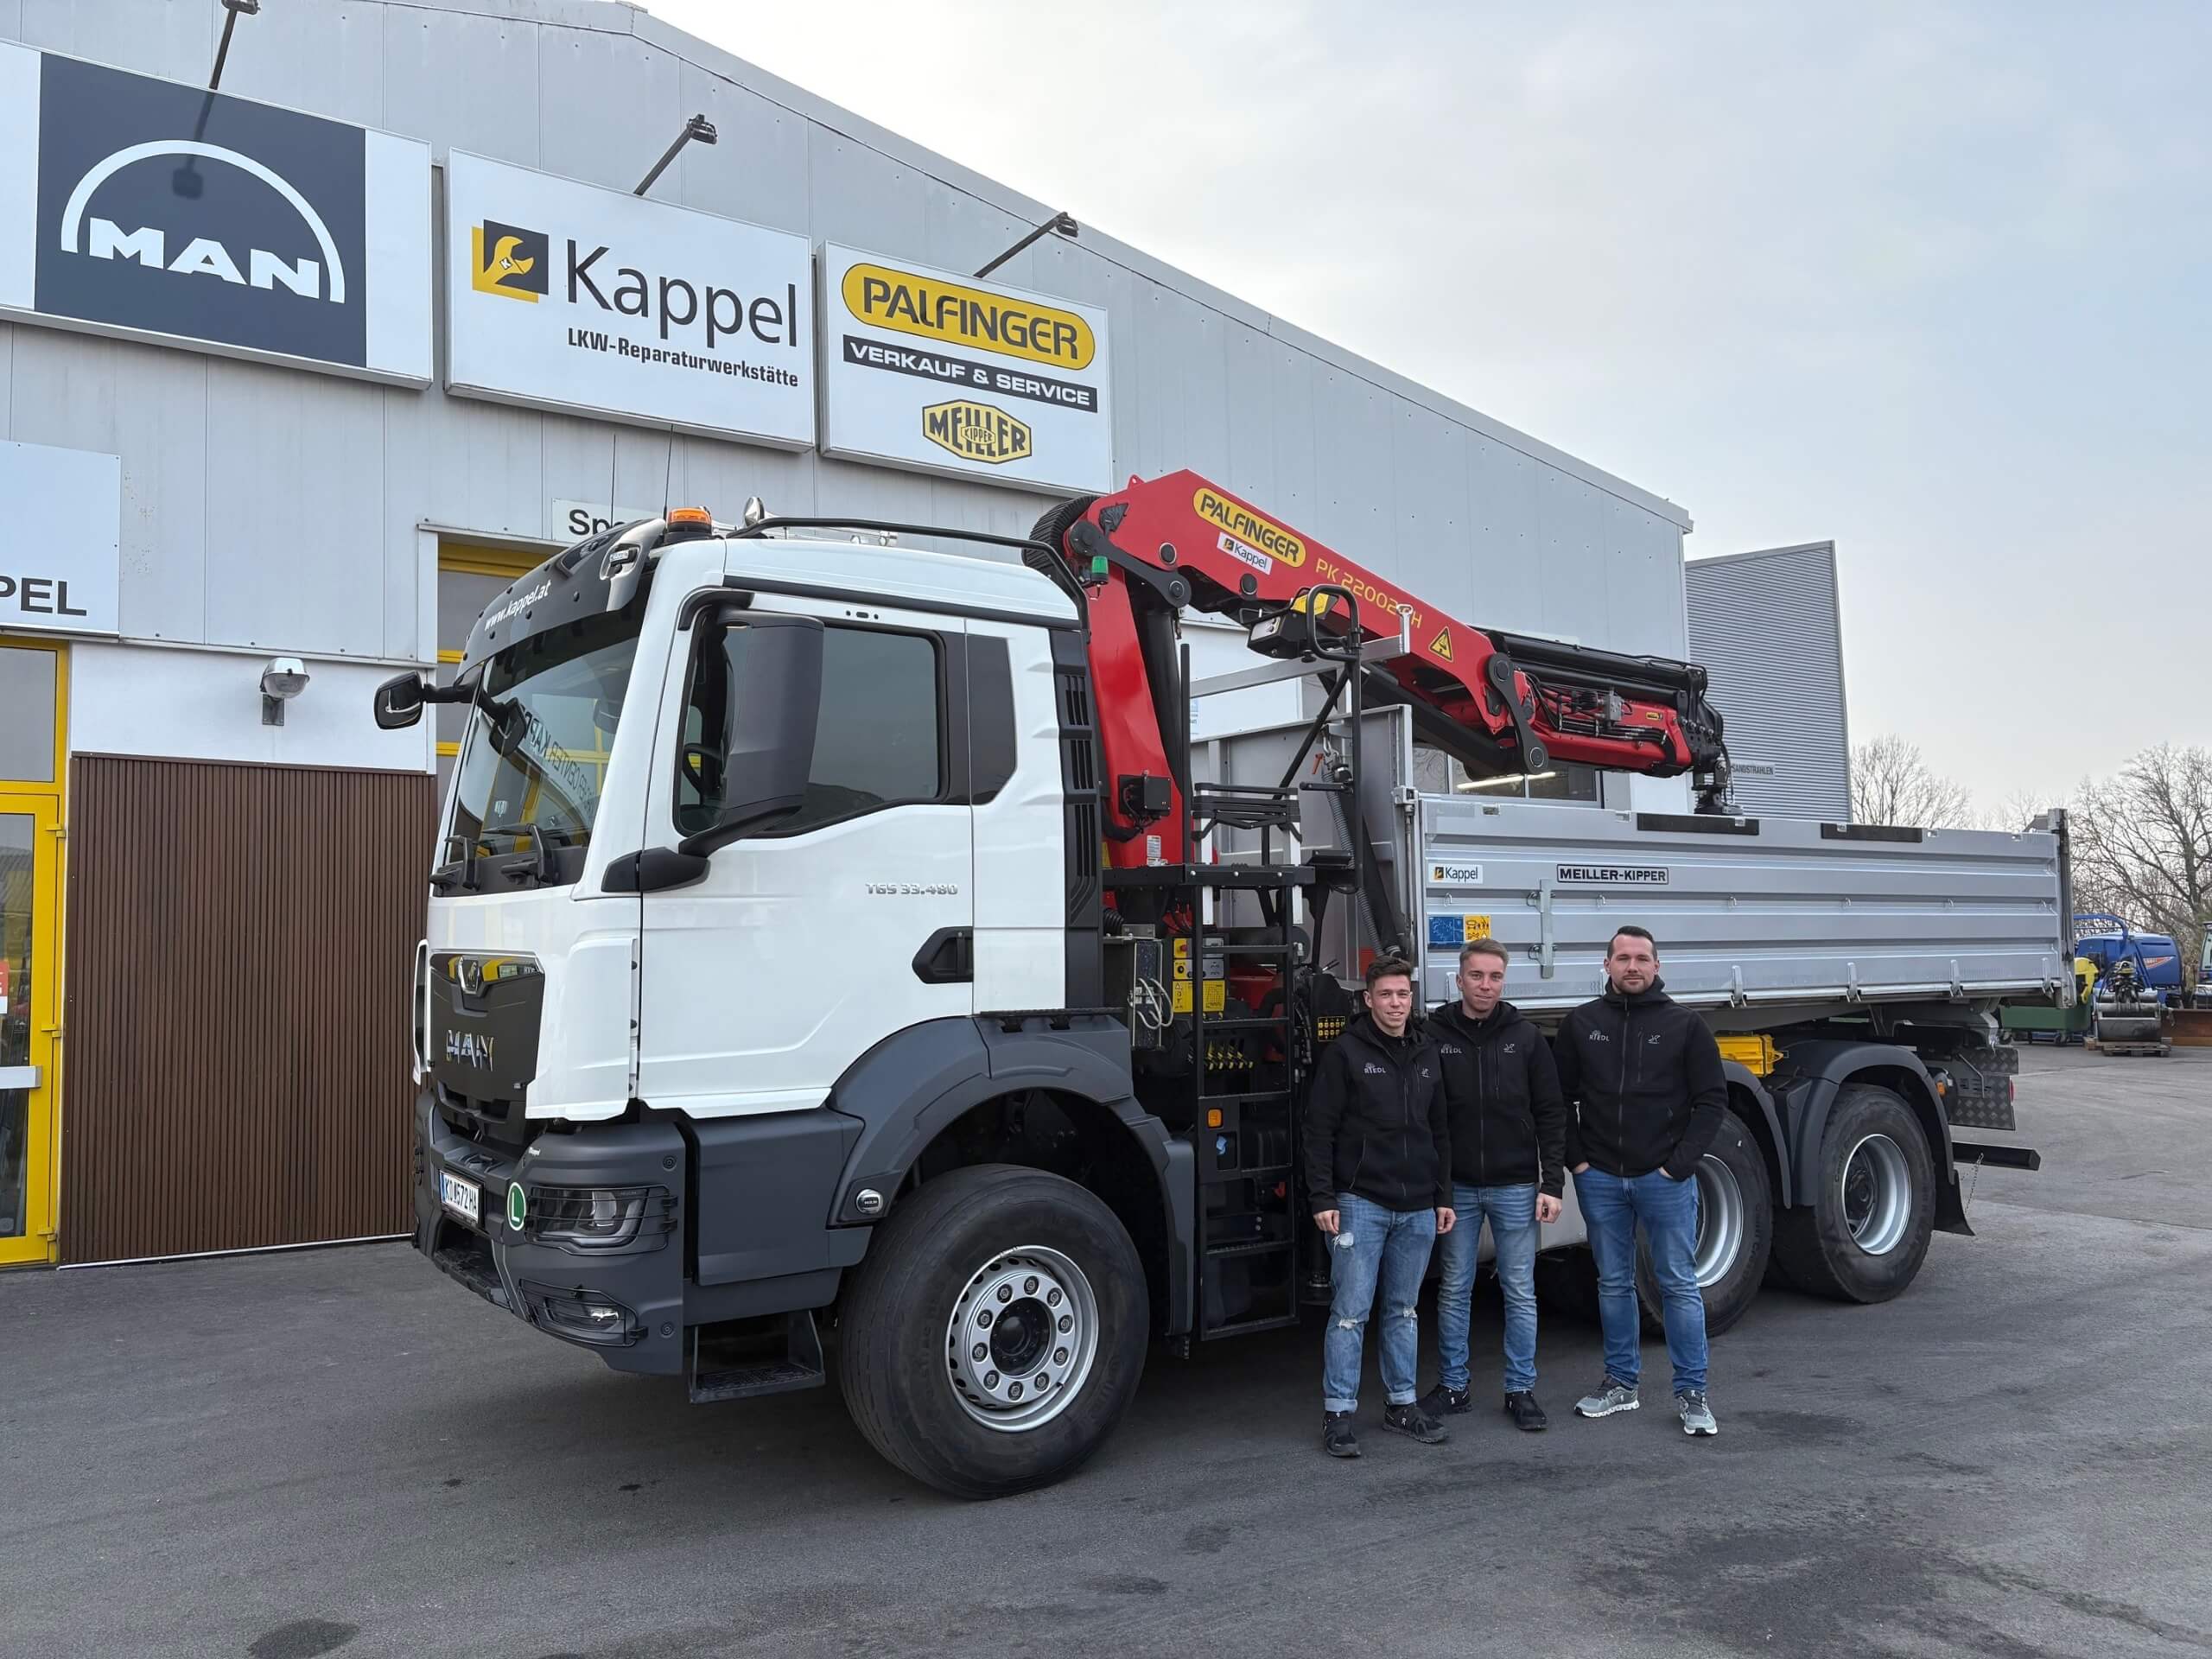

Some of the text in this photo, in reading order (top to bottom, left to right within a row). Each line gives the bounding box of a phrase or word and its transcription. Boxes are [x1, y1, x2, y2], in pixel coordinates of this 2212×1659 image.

[89, 217, 320, 300] MAN
[567, 238, 797, 349] Kappel
[863, 276, 1078, 360] PALFINGER
[568, 327, 798, 387] LKW-Reparaturwerkstätte
[850, 342, 1090, 406] VERKAUF & SERVICE
[929, 406, 1027, 457] MEILLER
[964, 428, 993, 443] KIPPER
[1200, 493, 1300, 563] PALFINGER
[1234, 543, 1268, 570] Kappel
[1315, 558, 1338, 583] PK
[484, 579, 551, 632] www.kappel.at
[865, 883, 958, 895] TGS 33.480
[1445, 867, 1478, 881] Kappel
[1560, 868, 1666, 882] MEILLER-KIPPER
[512, 1192, 520, 1223] L
